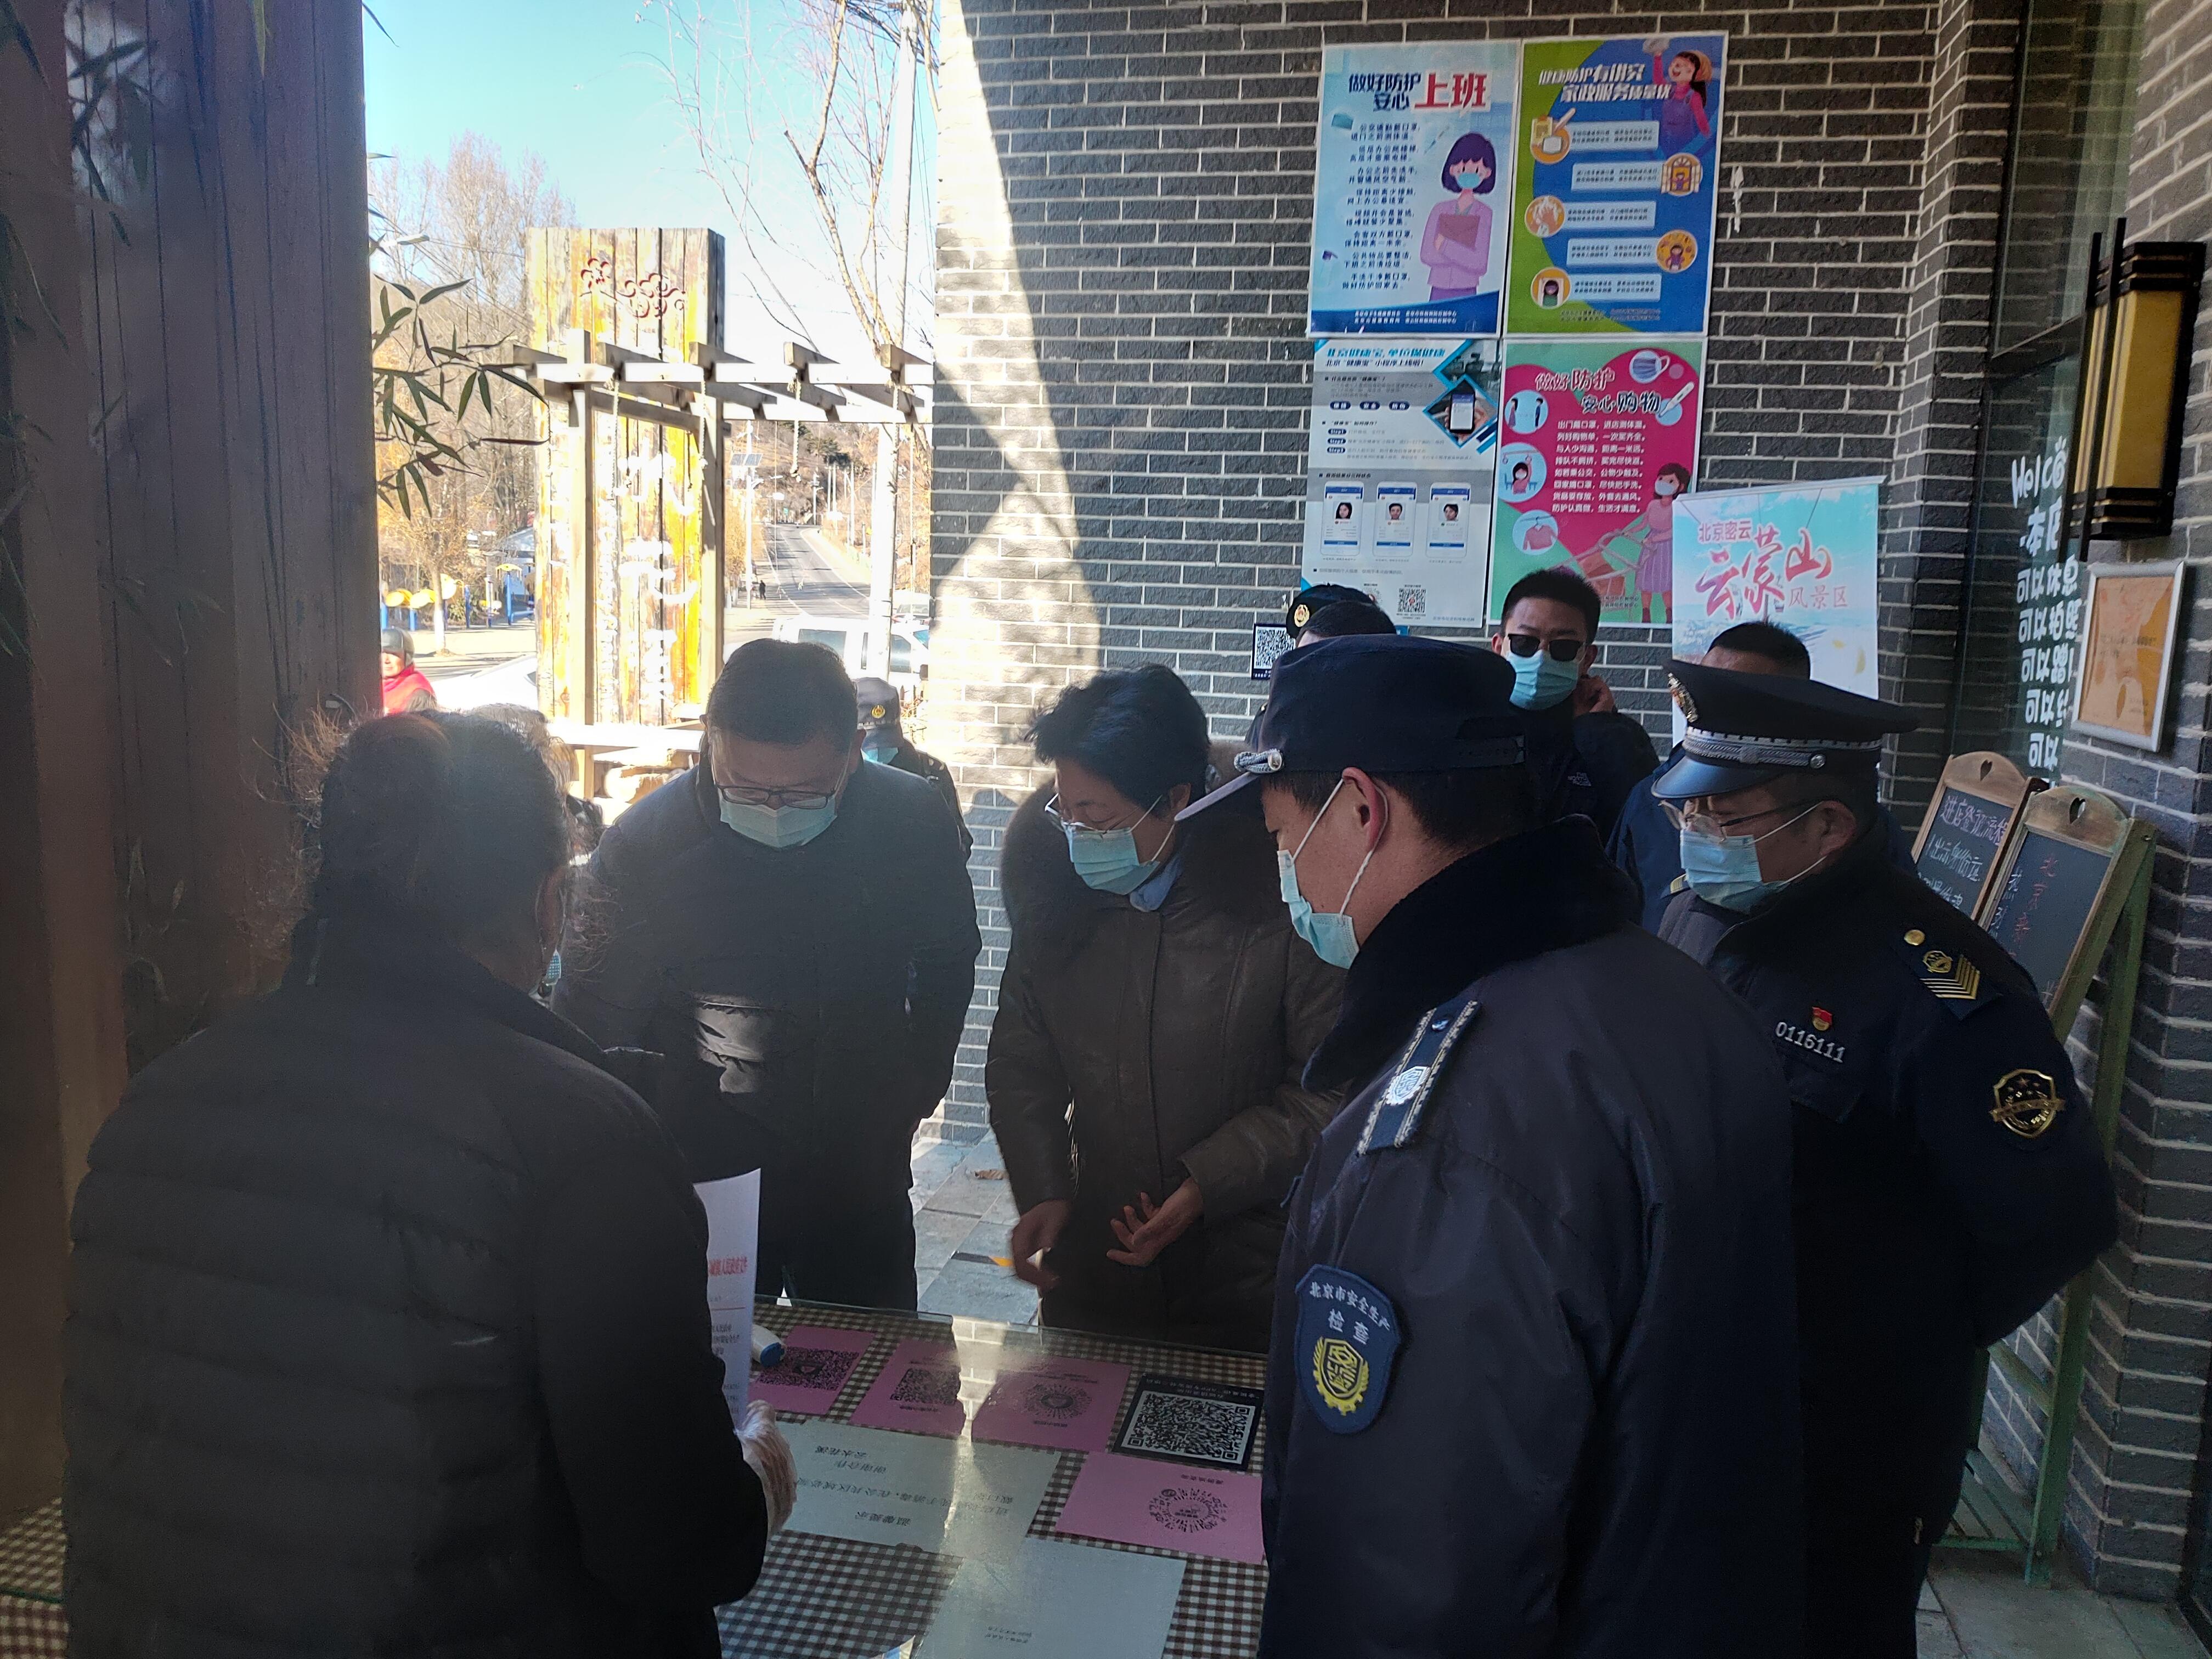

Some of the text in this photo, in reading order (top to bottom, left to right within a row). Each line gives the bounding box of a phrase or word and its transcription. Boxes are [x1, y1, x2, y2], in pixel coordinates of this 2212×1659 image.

[1349, 72, 1422, 93] 做好防护
[1414, 72, 1488, 109] 上班
[1373, 91, 1410, 112] 安心
[1535, 367, 1615, 392] 做好防护
[1581, 391, 1662, 414] 安心购物
[1699, 520, 1753, 543] 北京密云
[1695, 527, 1832, 619] 云蒙山
[2016, 554, 2079, 603] 可以休息
[1788, 585, 1848, 610] 风景区
[2018, 599, 2083, 644] 可以拍照
[2028, 732, 2059, 771] 可以
[1775, 1021, 1846, 1064] 0116111
[1309, 1281, 1391, 1331] 北京市安全生产
[1328, 1308, 1370, 1345] 检查
